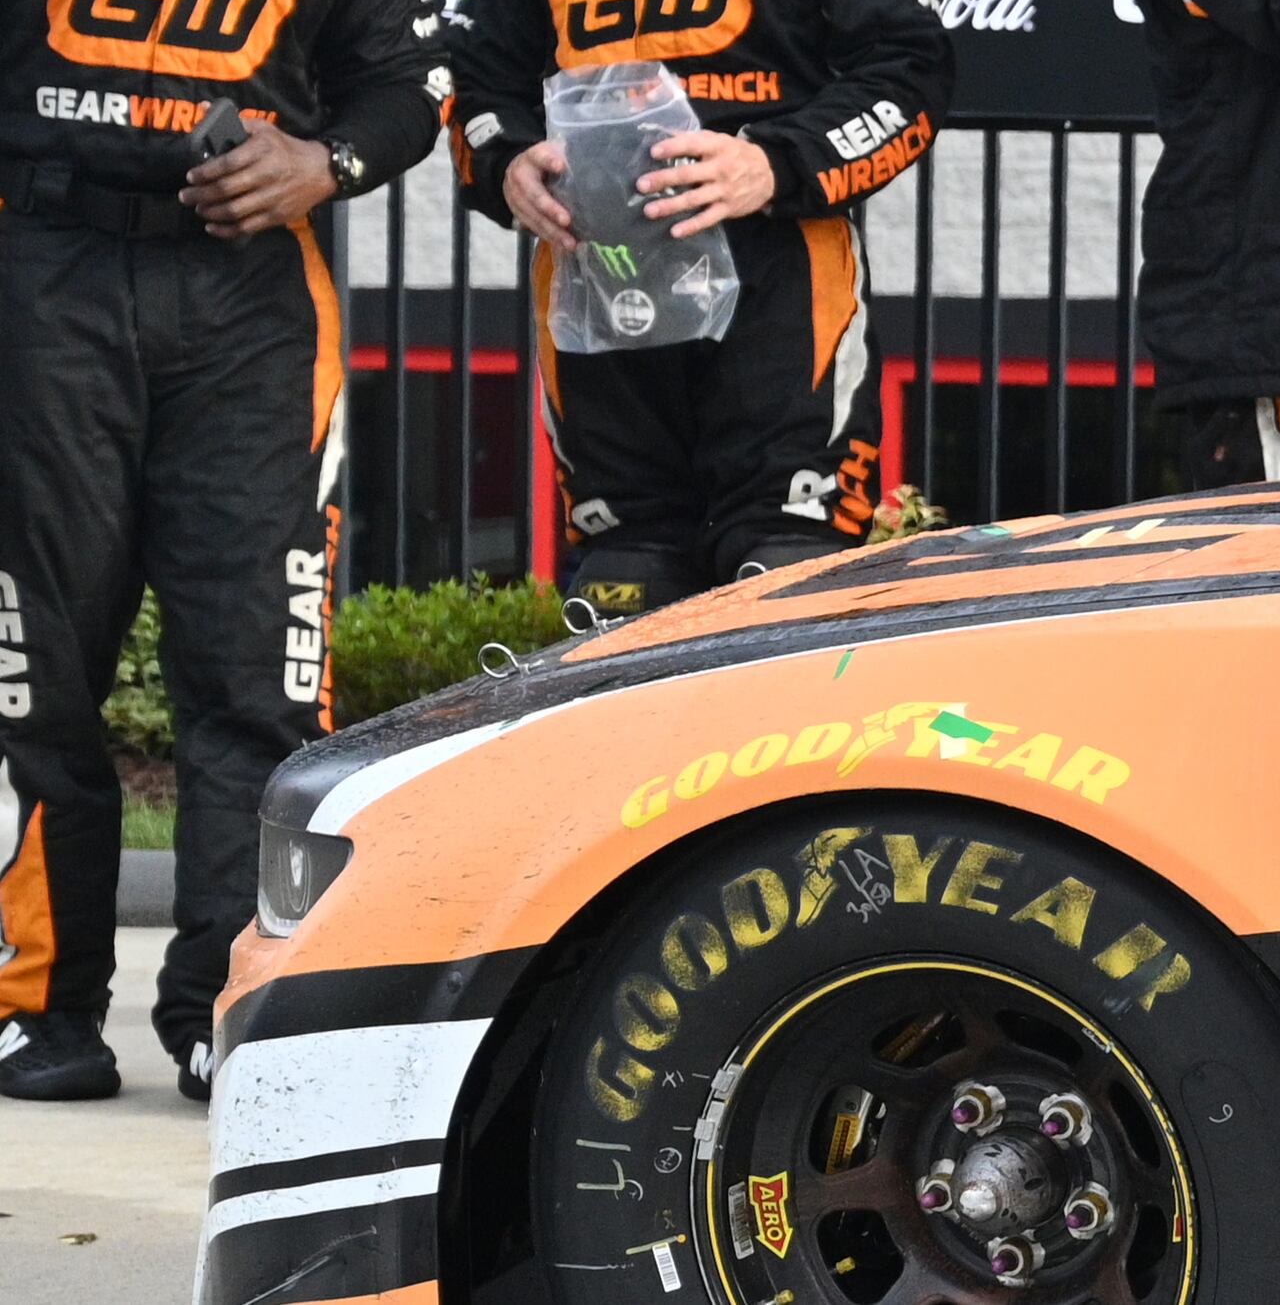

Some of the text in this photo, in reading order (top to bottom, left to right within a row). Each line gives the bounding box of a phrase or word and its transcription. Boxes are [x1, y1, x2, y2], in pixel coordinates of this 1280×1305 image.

[817, 112, 934, 206] WRENCH
[825, 100, 908, 161] GEAR
[284, 548, 325, 704] GEAR
[584, 825, 1193, 1122] GOODYEAR
[758, 1187, 785, 1243] AERO
